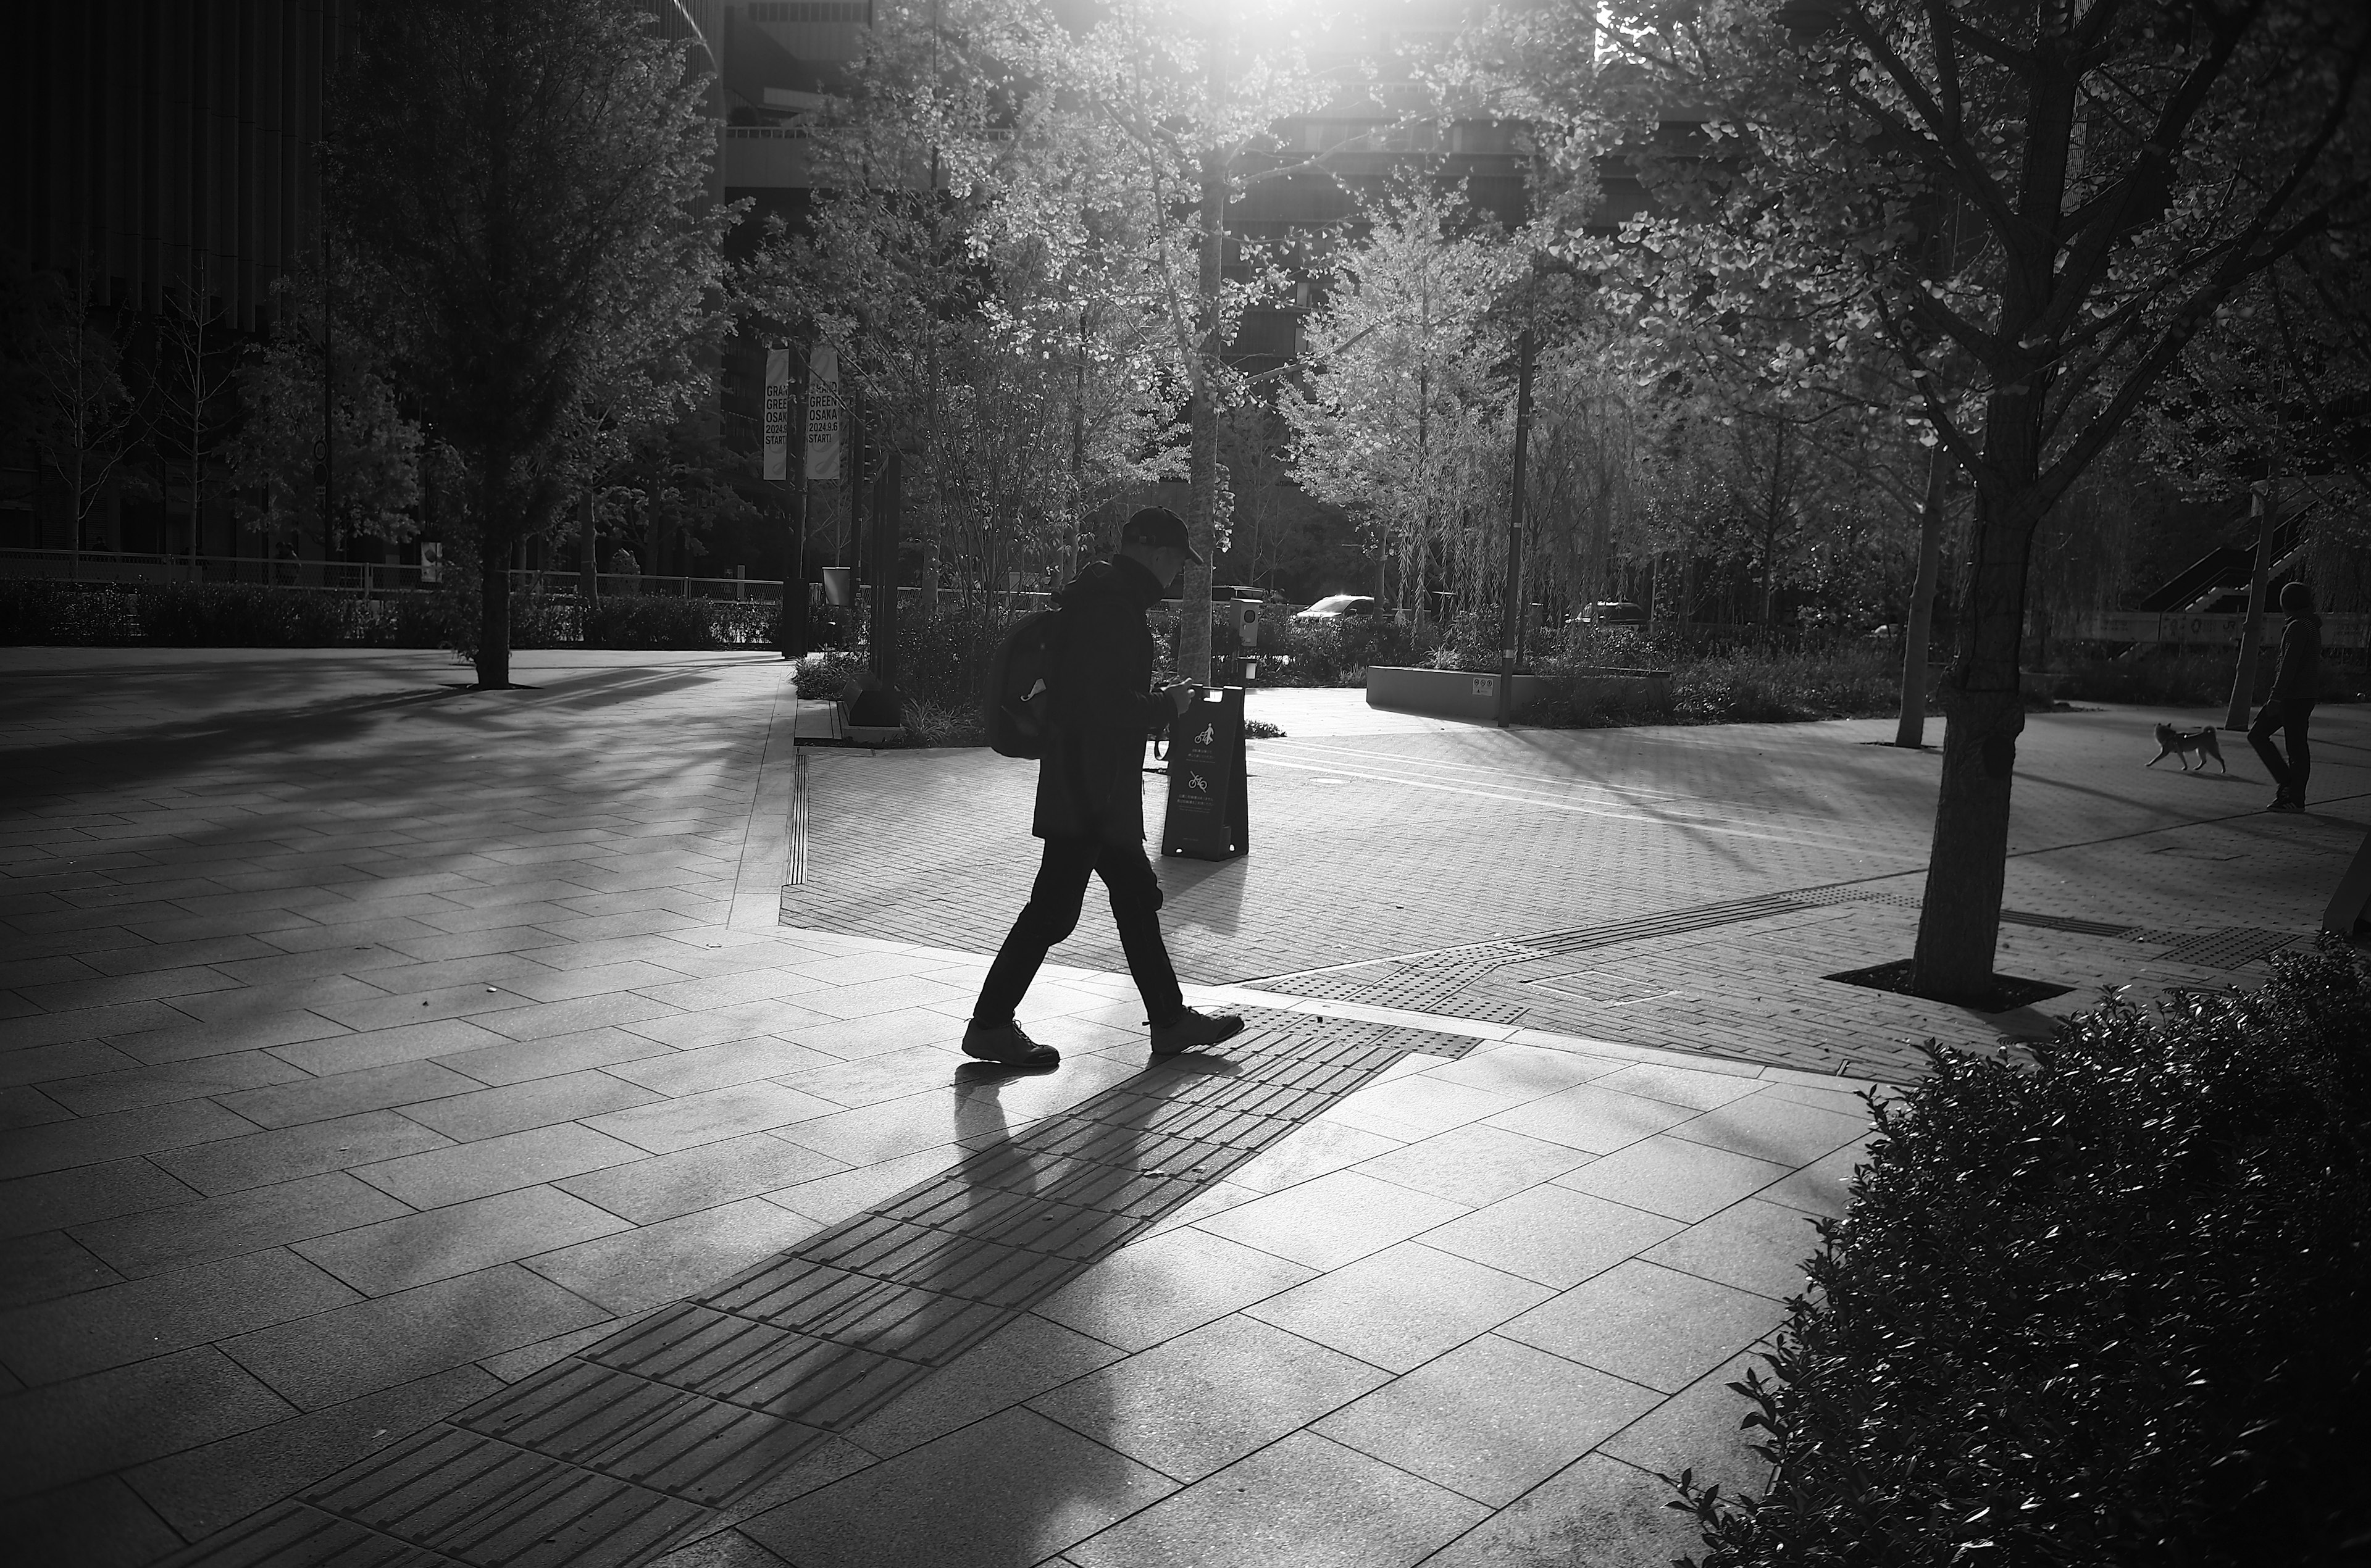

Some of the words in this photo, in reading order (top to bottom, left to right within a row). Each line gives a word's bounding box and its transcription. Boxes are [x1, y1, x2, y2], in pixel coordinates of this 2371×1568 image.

[767, 385, 787, 396] GRAN
[766, 398, 787, 409] GREE
[810, 395, 837, 407] GREEN
[766, 412, 787, 422] OSAK
[809, 409, 837, 420] OSAKA
[766, 424, 787, 433] 2024.9
[809, 422, 838, 432] 2024.9.6
[765, 435, 785, 444] START
[809, 433, 831, 443] START!
[2223, 621, 2236, 630] JR
